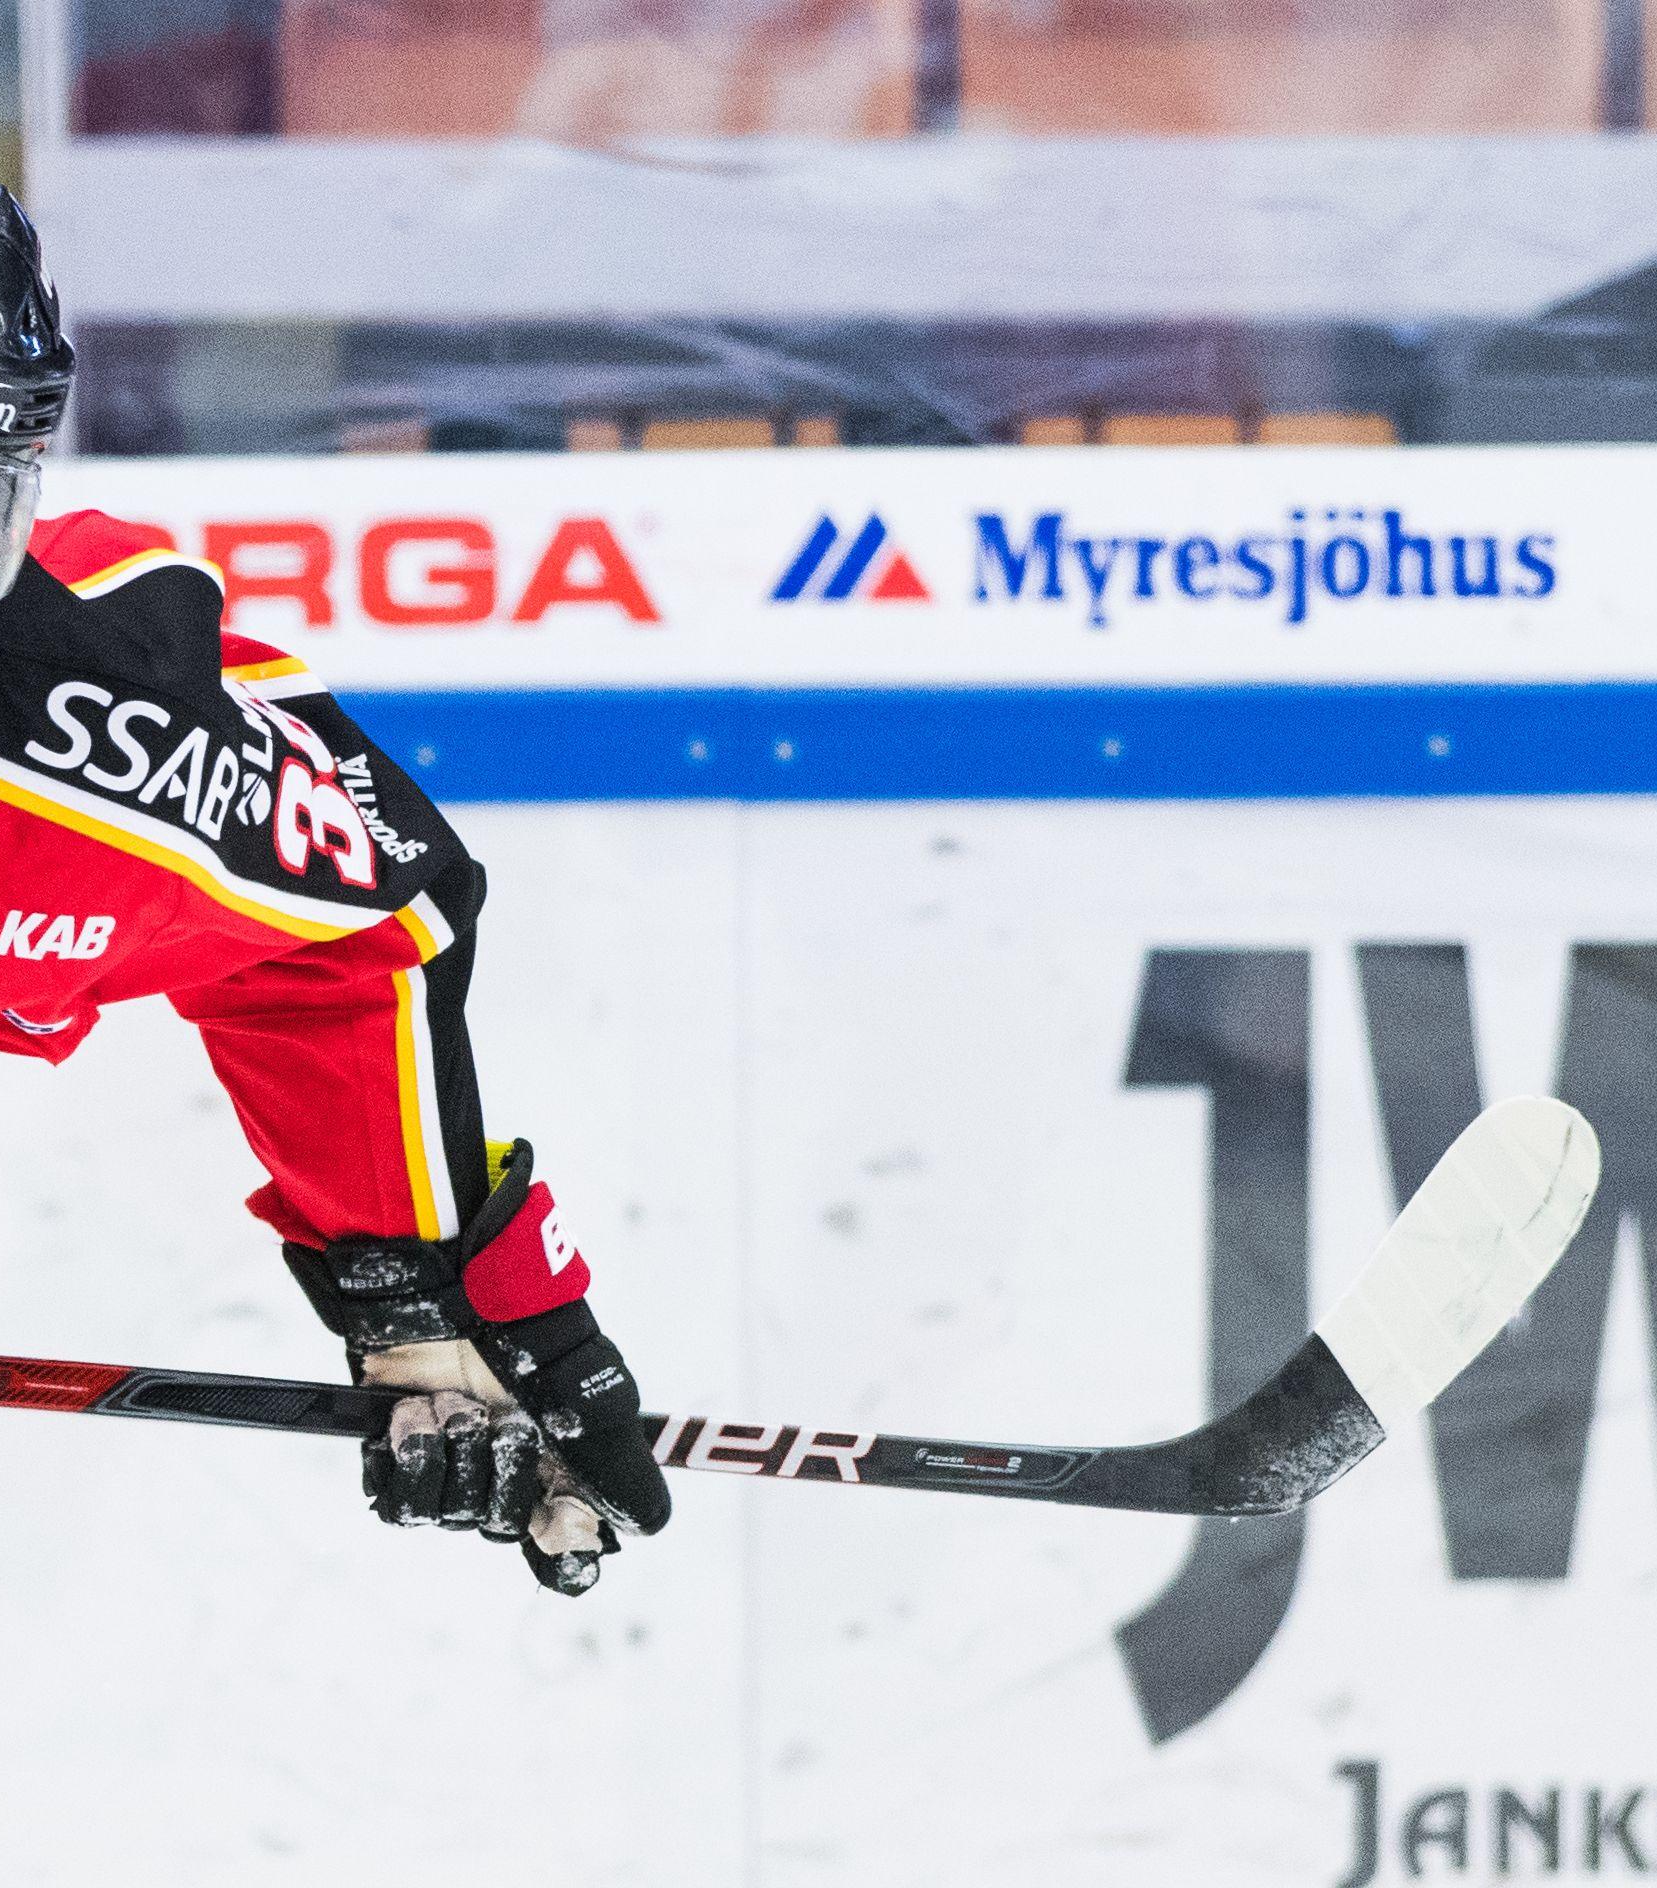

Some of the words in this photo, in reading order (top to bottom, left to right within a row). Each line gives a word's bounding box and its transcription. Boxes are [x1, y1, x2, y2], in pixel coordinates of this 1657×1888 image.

[132, 517, 662, 628] RGA
[972, 509, 1558, 628] Myresjöhus
[24, 681, 239, 842] SSAB
